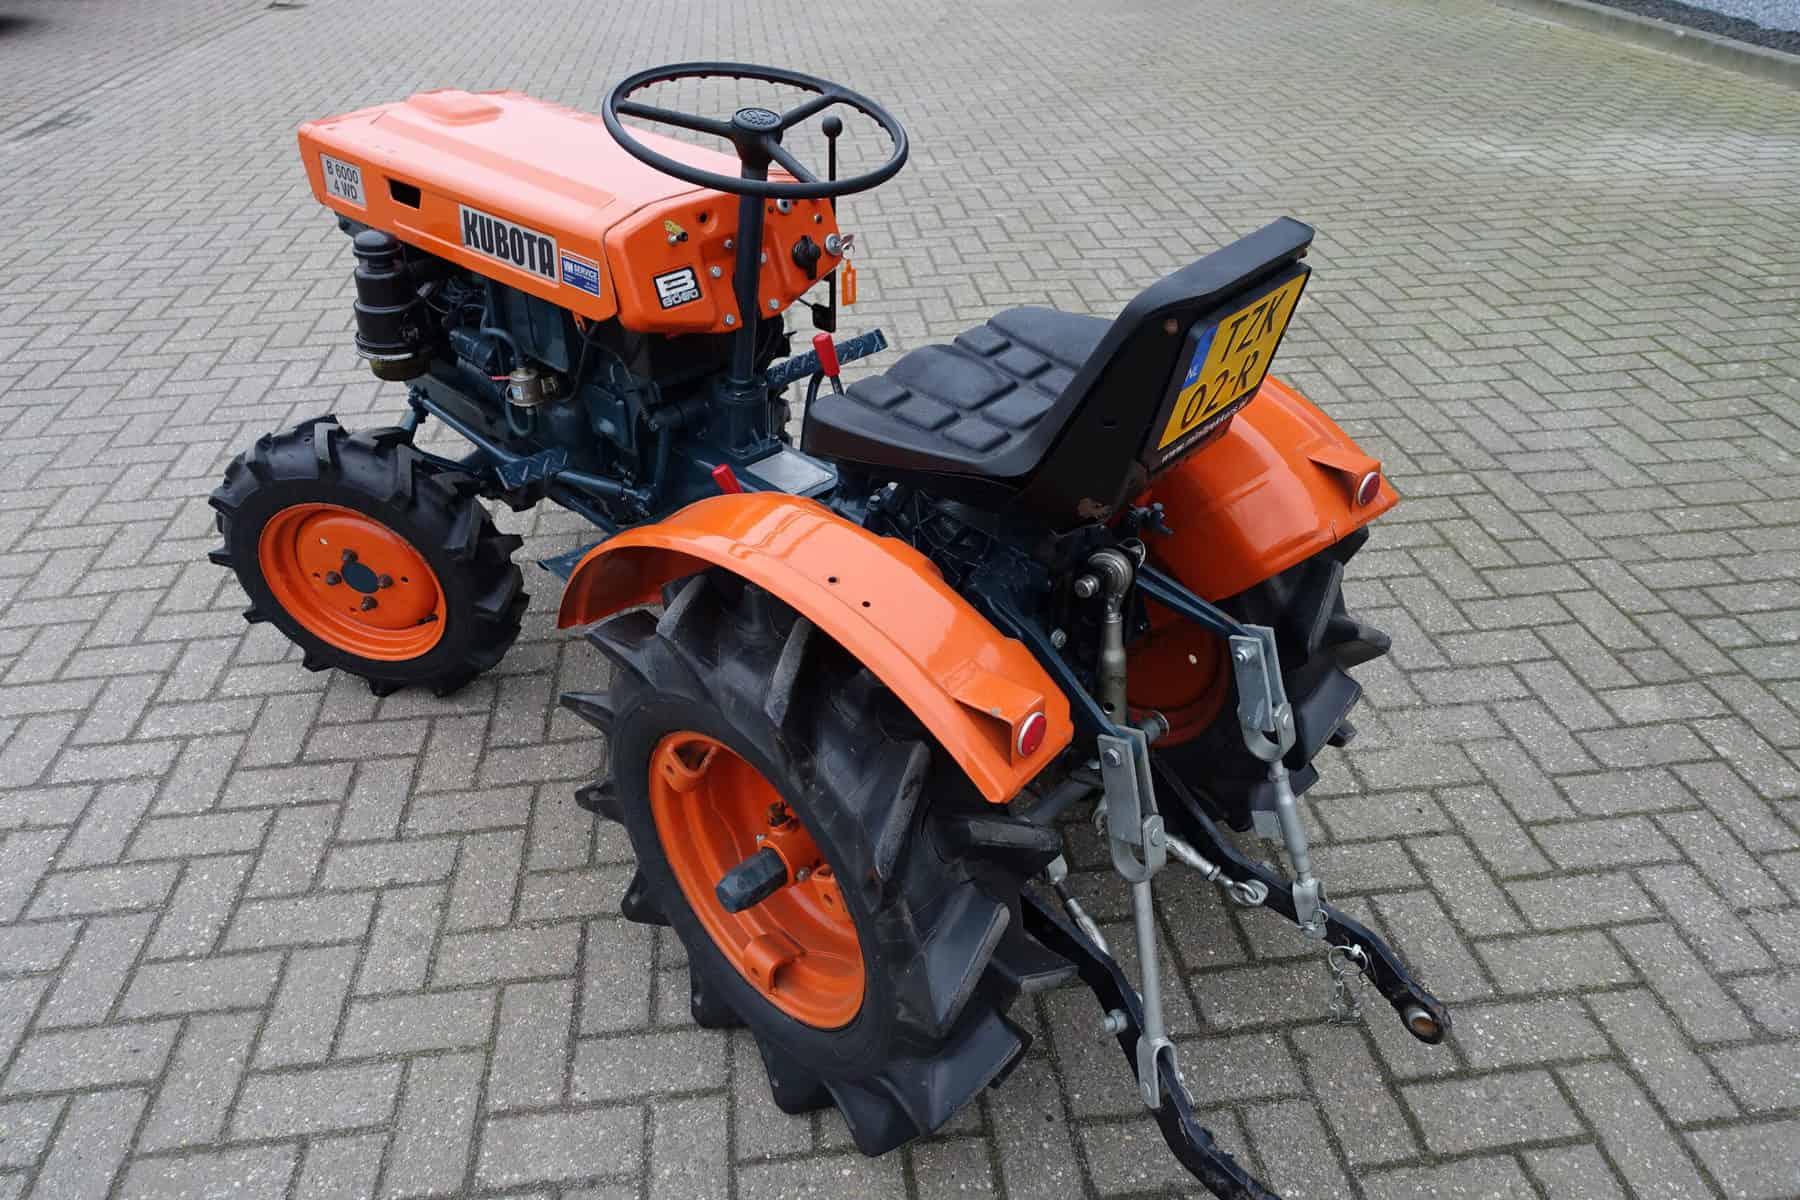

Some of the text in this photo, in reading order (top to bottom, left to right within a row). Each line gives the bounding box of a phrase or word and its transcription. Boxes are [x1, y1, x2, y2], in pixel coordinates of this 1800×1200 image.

[326, 159, 359, 185] B 6000
[334, 179, 357, 200] 4 WD
[463, 209, 555, 279] KUBOTA
[655, 268, 696, 298] B
[1220, 289, 1288, 363] TZK
[1181, 350, 1259, 429] 02-R
